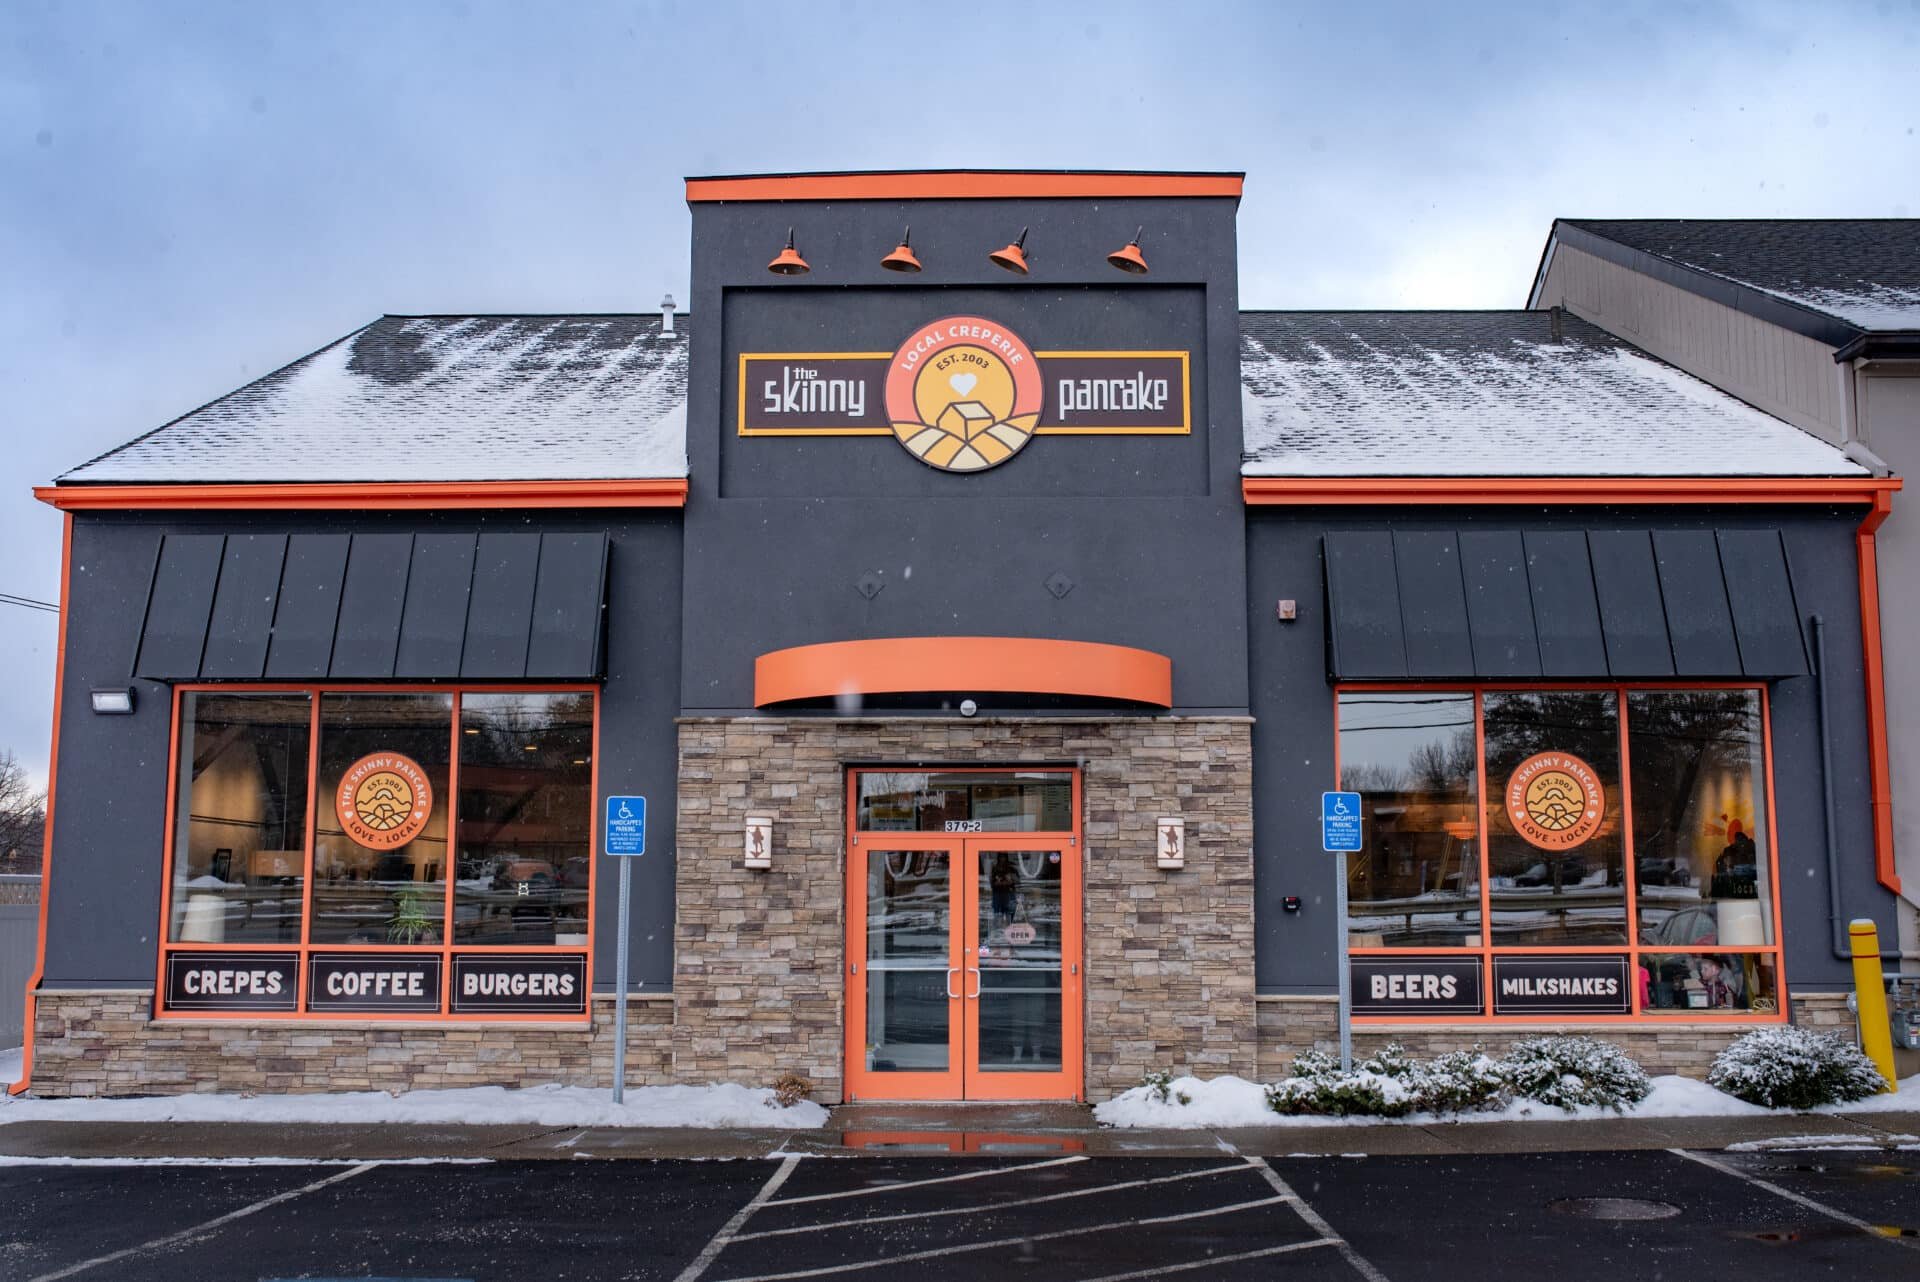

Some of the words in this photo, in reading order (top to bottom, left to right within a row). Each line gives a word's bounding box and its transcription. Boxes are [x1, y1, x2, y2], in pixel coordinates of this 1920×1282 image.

[901, 331, 945, 371] LOCAL
[948, 325, 1023, 365] CREPERIE
[792, 367, 818, 380] the
[936, 353, 959, 371] EST.
[961, 353, 989, 369] 2003
[764, 366, 865, 416] skinny
[1059, 371, 1168, 420] pancake
[342, 783, 354, 807] THE
[350, 758, 393, 782] SKINNY
[395, 760, 427, 807] PANCAKE
[1512, 783, 1522, 807] THE
[1519, 757, 1560, 782] SKINNY
[1563, 759, 1599, 806] PANCAKE
[349, 821, 375, 842] LOVE
[386, 821, 418, 843] LOCAL
[946, 821, 981, 832] 379-2
[1521, 821, 1549, 843] LOVE
[1560, 821, 1592, 843] LOCAL
[184, 970, 283, 994] CREPES
[327, 972, 424, 997] COFFEE
[463, 973, 574, 996] BURGERS
[1370, 974, 1457, 1000] BEERS
[1502, 977, 1618, 996] MILKSHAKES
